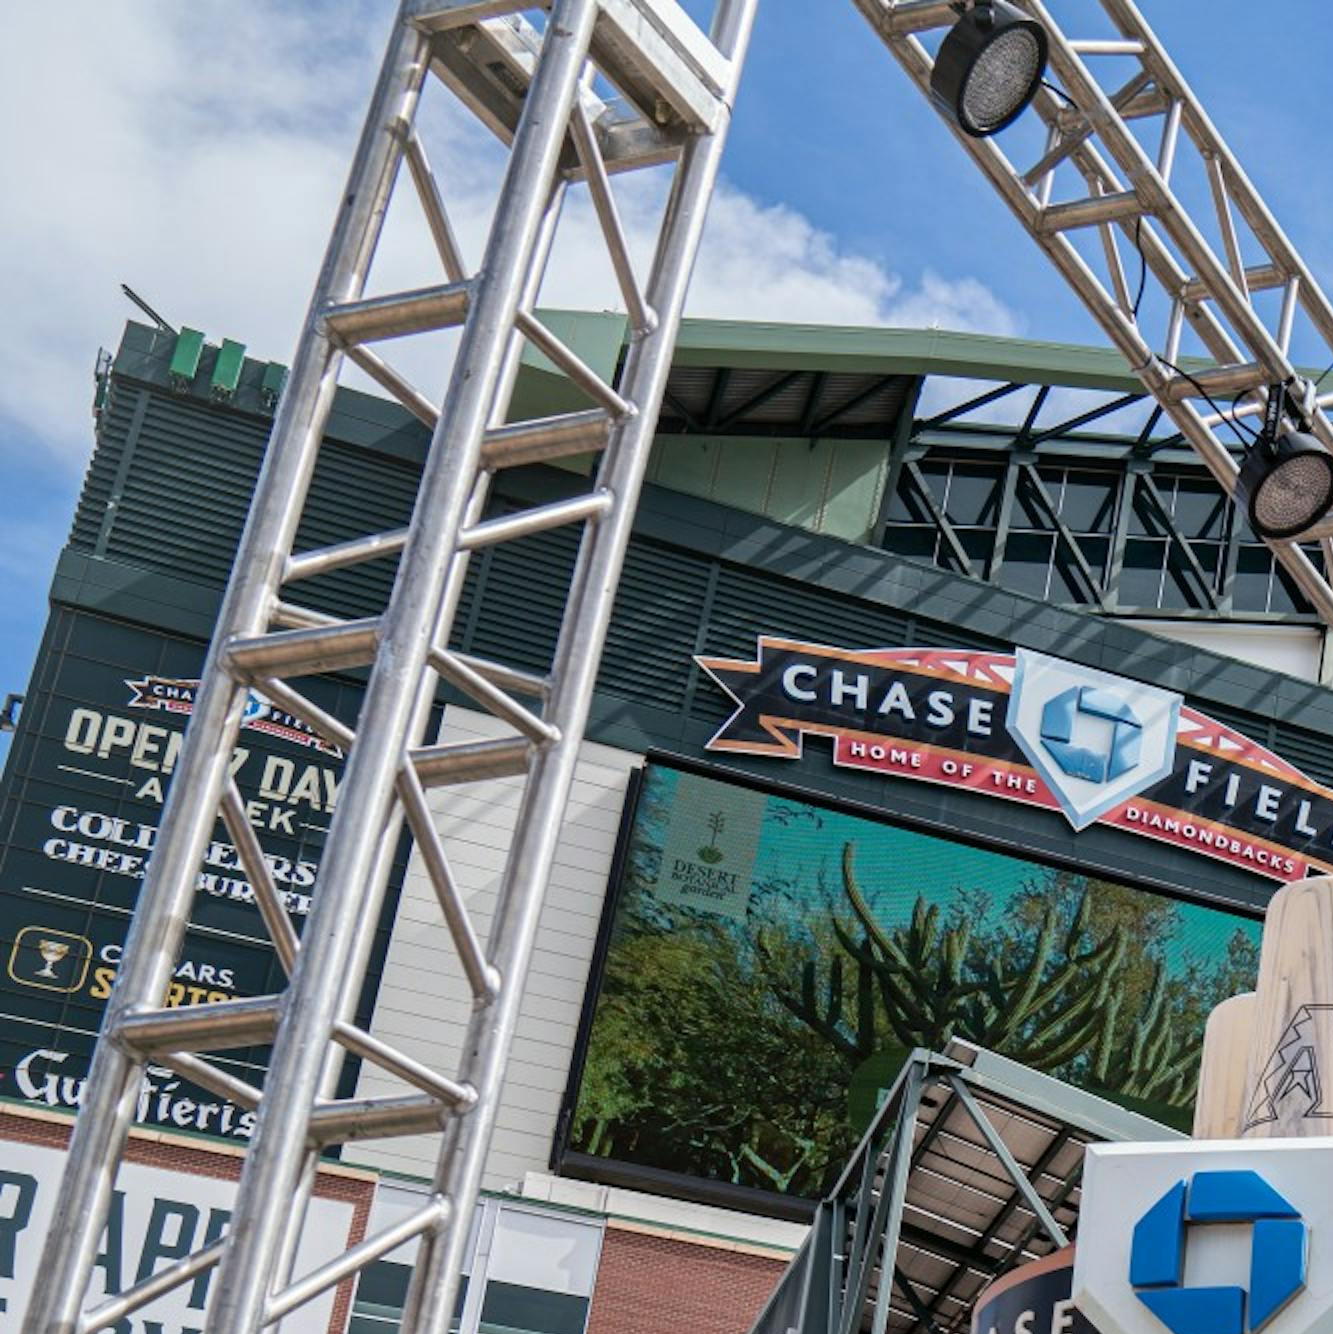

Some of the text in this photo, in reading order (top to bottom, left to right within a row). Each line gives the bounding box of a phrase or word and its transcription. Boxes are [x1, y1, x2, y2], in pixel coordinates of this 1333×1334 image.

[153, 683, 199, 701] CHA
[782, 663, 995, 737] CHASE
[851, 742, 1295, 874] HOME OF THE DIAMONDBACKS
